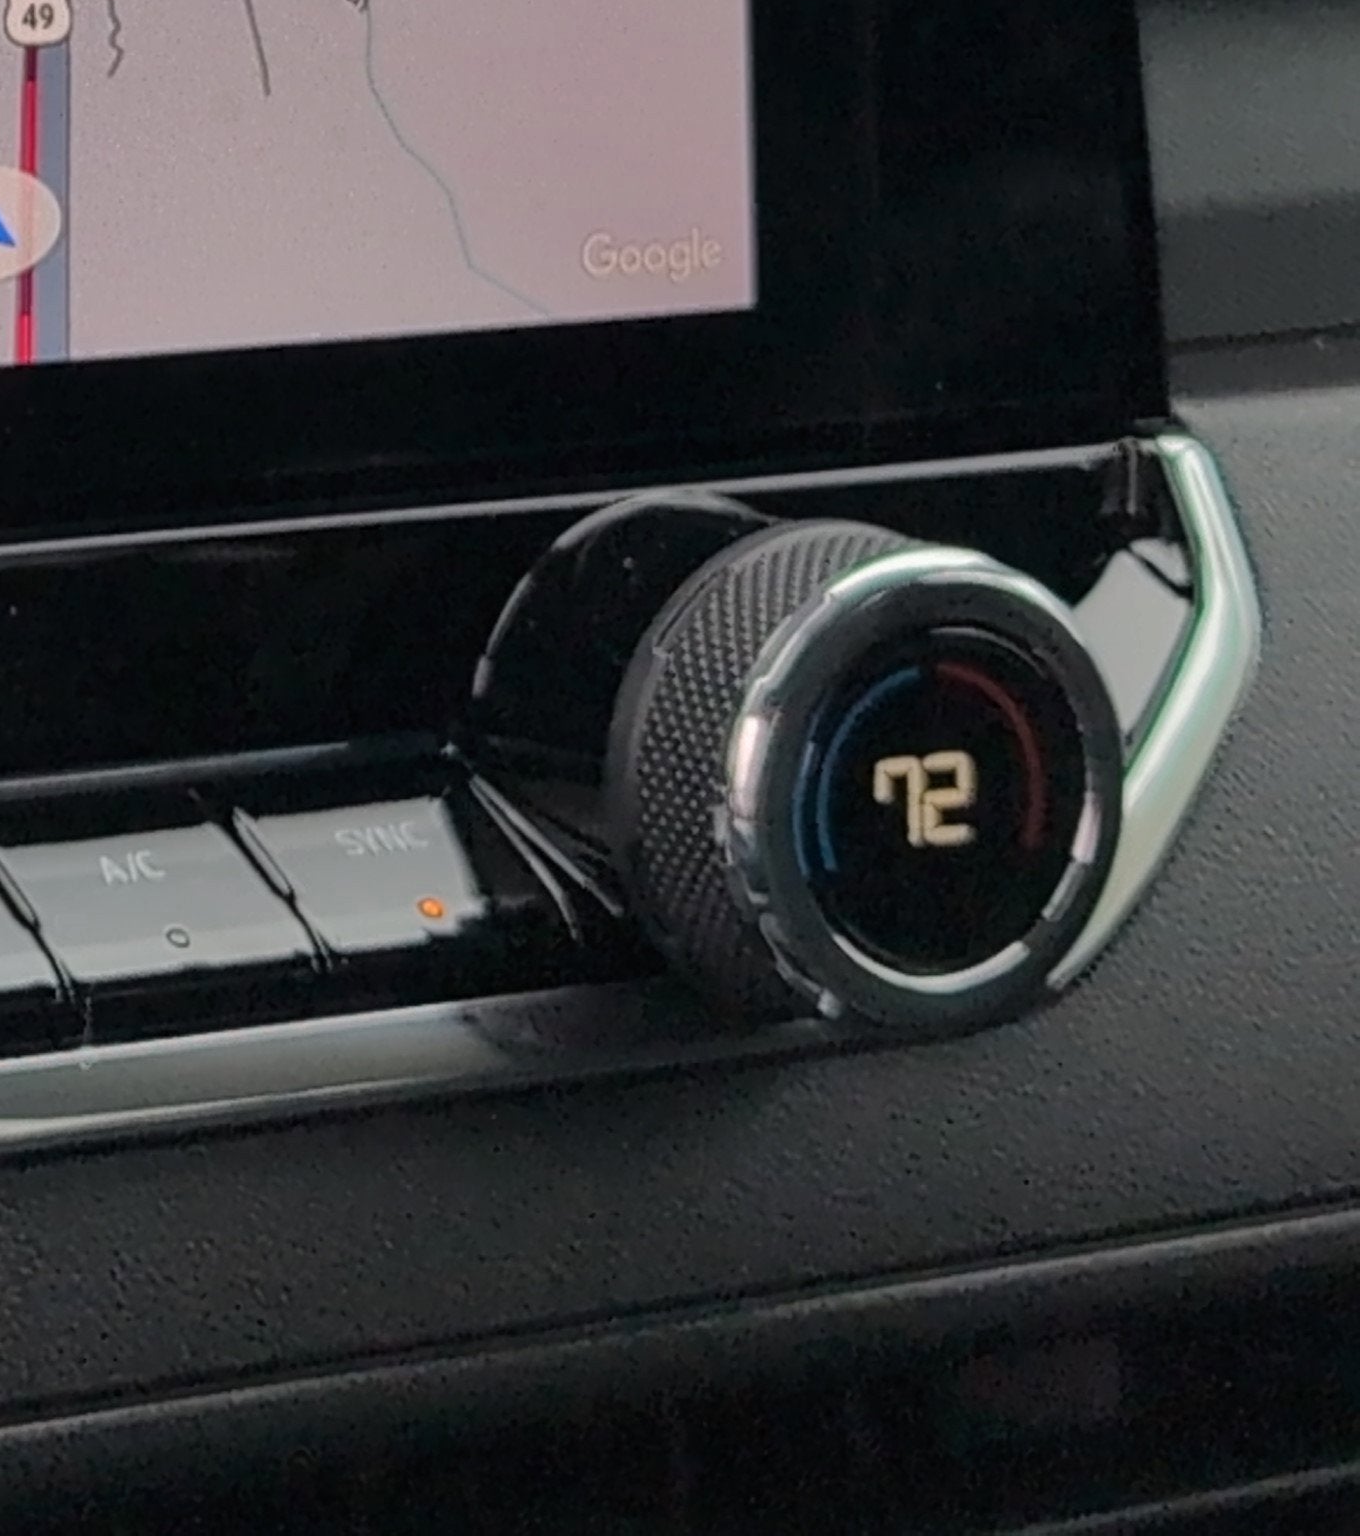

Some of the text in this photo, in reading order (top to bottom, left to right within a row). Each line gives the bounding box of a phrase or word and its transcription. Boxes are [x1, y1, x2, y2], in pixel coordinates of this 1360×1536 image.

[22, 1, 55, 30] 49
[582, 227, 722, 283] Google
[873, 749, 978, 849] 72
[333, 819, 430, 859] SYNC
[99, 850, 167, 887] A/C
